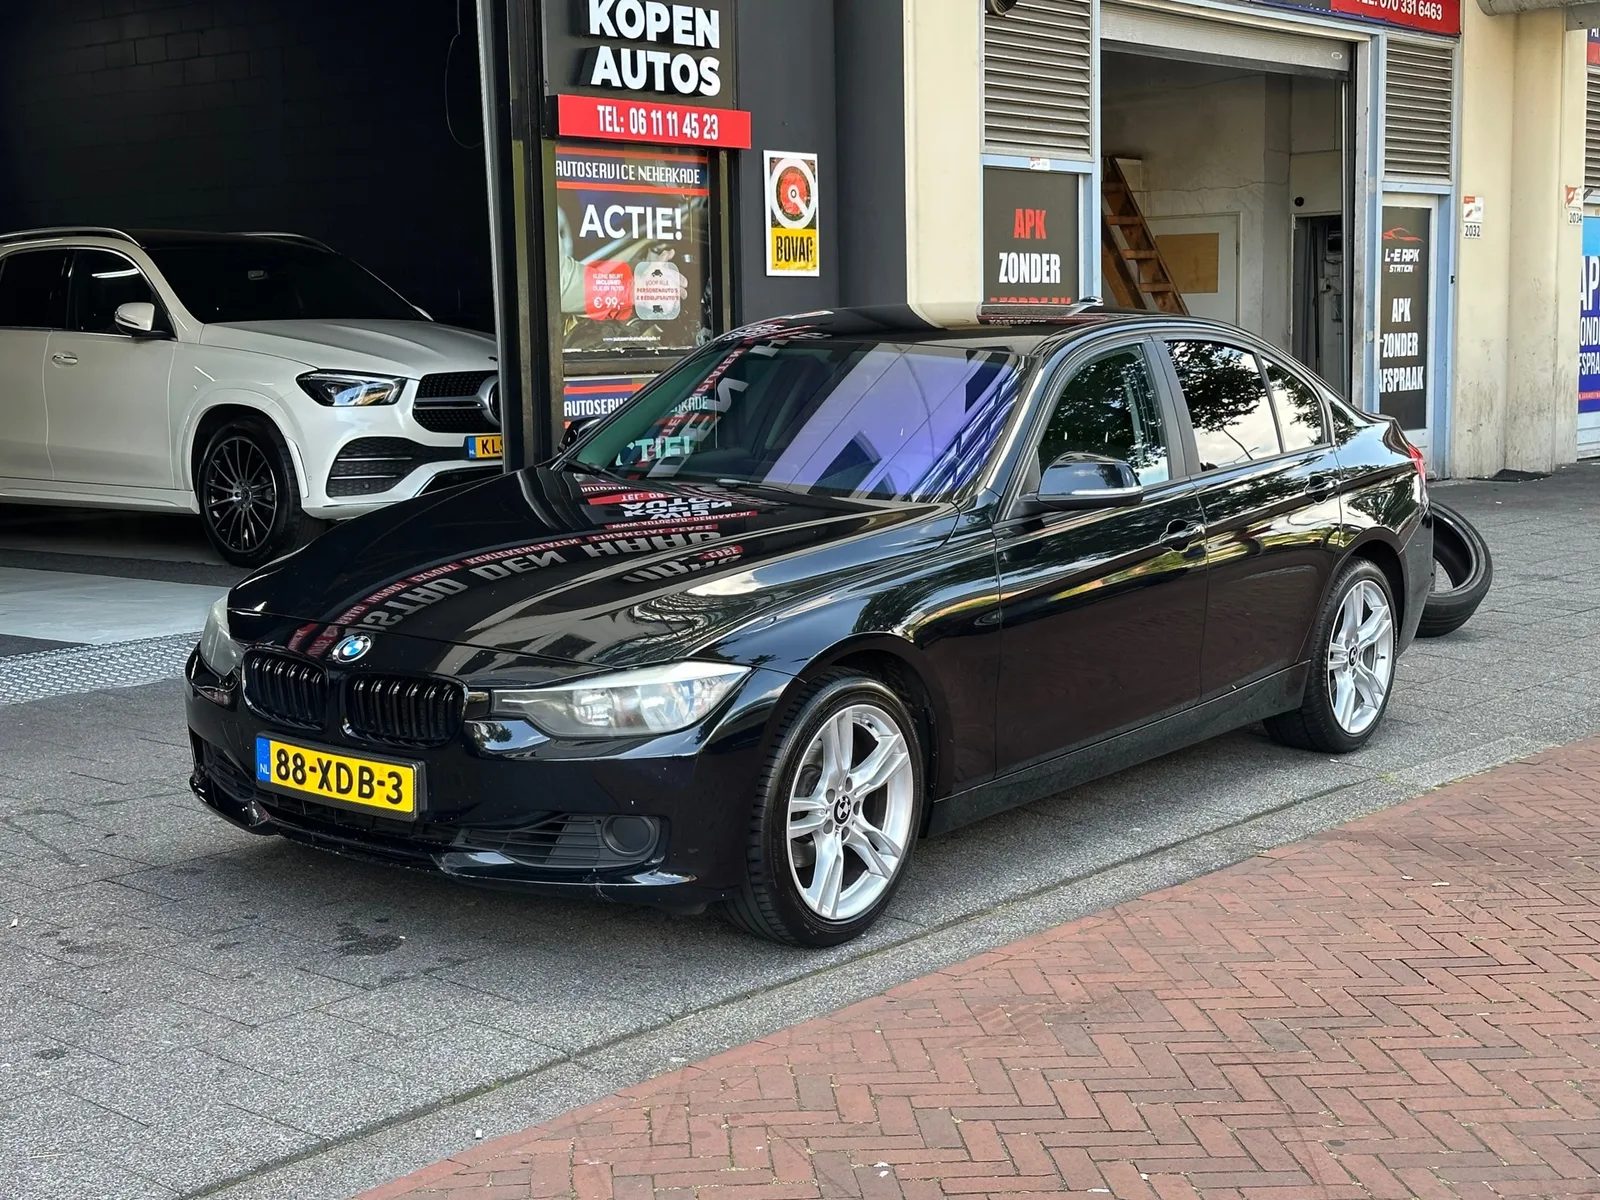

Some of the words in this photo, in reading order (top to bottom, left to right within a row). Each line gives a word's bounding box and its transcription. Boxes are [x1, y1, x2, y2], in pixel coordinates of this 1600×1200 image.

[589, 0, 720, 49] KOPEN
[1400, 0, 1416, 15] 331
[1418, 1, 1442, 20] 6463
[590, 46, 721, 97] AUTOS
[597, 105, 624, 133] TEL:
[629, 107, 647, 135] 06
[650, 109, 663, 136] 11
[666, 110, 678, 137] 11
[682, 112, 699, 139] 45
[703, 113, 719, 140] 23
[555, 160, 636, 181] AUTOSERVICE
[638, 165, 701, 185] NEHERKADE
[579, 204, 682, 241] ACTIE!
[1013, 208, 1047, 240] APK
[1465, 225, 1481, 237] 2032
[775, 235, 814, 263] BOVAG
[998, 252, 1061, 284] ZONDER
[1580, 255, 1600, 310] AP
[1391, 298, 1412, 323] APK
[1382, 332, 1419, 358] ZONDER
[1580, 316, 1600, 346] OND
[1379, 366, 1424, 393] AFSPRAAK
[259, 763, 270, 775] NL
[276, 748, 403, 805] 88-XDB-3
